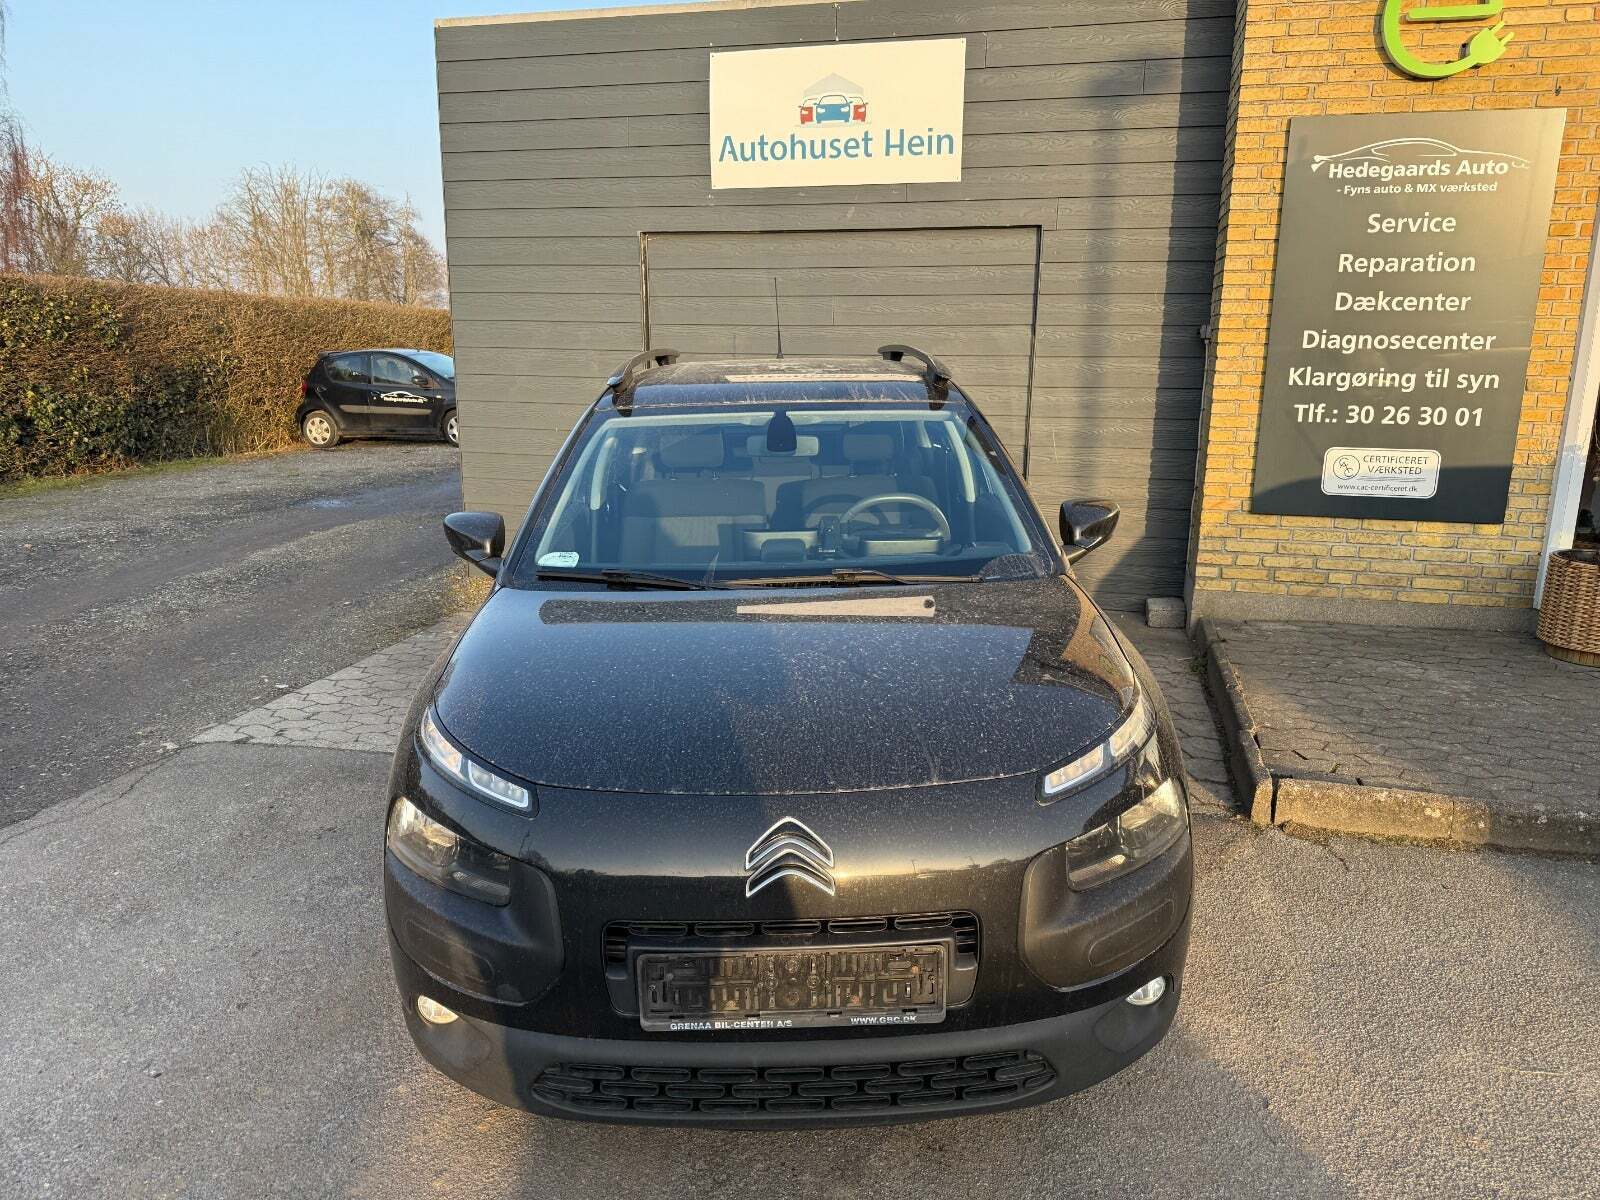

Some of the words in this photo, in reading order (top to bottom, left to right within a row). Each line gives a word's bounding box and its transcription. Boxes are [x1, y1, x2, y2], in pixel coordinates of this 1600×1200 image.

[718, 130, 873, 162] Autohuset
[885, 127, 954, 157] Hein
[1328, 161, 1451, 182] Hedegaards
[1456, 159, 1509, 176] Auto
[1343, 185, 1371, 197] Fyns
[1373, 184, 1401, 194] auto
[1404, 183, 1413, 193] &
[1416, 183, 1437, 193] MX
[1440, 181, 1498, 193] værksted
[1367, 212, 1457, 233] Service
[1338, 252, 1476, 278] Reparation
[1335, 291, 1472, 312] Dækcenter
[1302, 329, 1496, 354] Diagnosecenter
[1288, 366, 1417, 393] Klargøring
[1424, 368, 1450, 388] til
[1456, 373, 1500, 394] syn
[1294, 403, 1338, 424] Tlf.:
[1345, 405, 1375, 424] 30
[1381, 406, 1411, 425] 26
[1417, 407, 1447, 426] 30
[1455, 407, 1483, 427] 01
[1363, 455, 1429, 465] CERTIFICERET
[1367, 465, 1422, 475] VÆRKSTED
[670, 1022, 712, 1031] GRENAA
[776, 1019, 793, 1028] A/S
